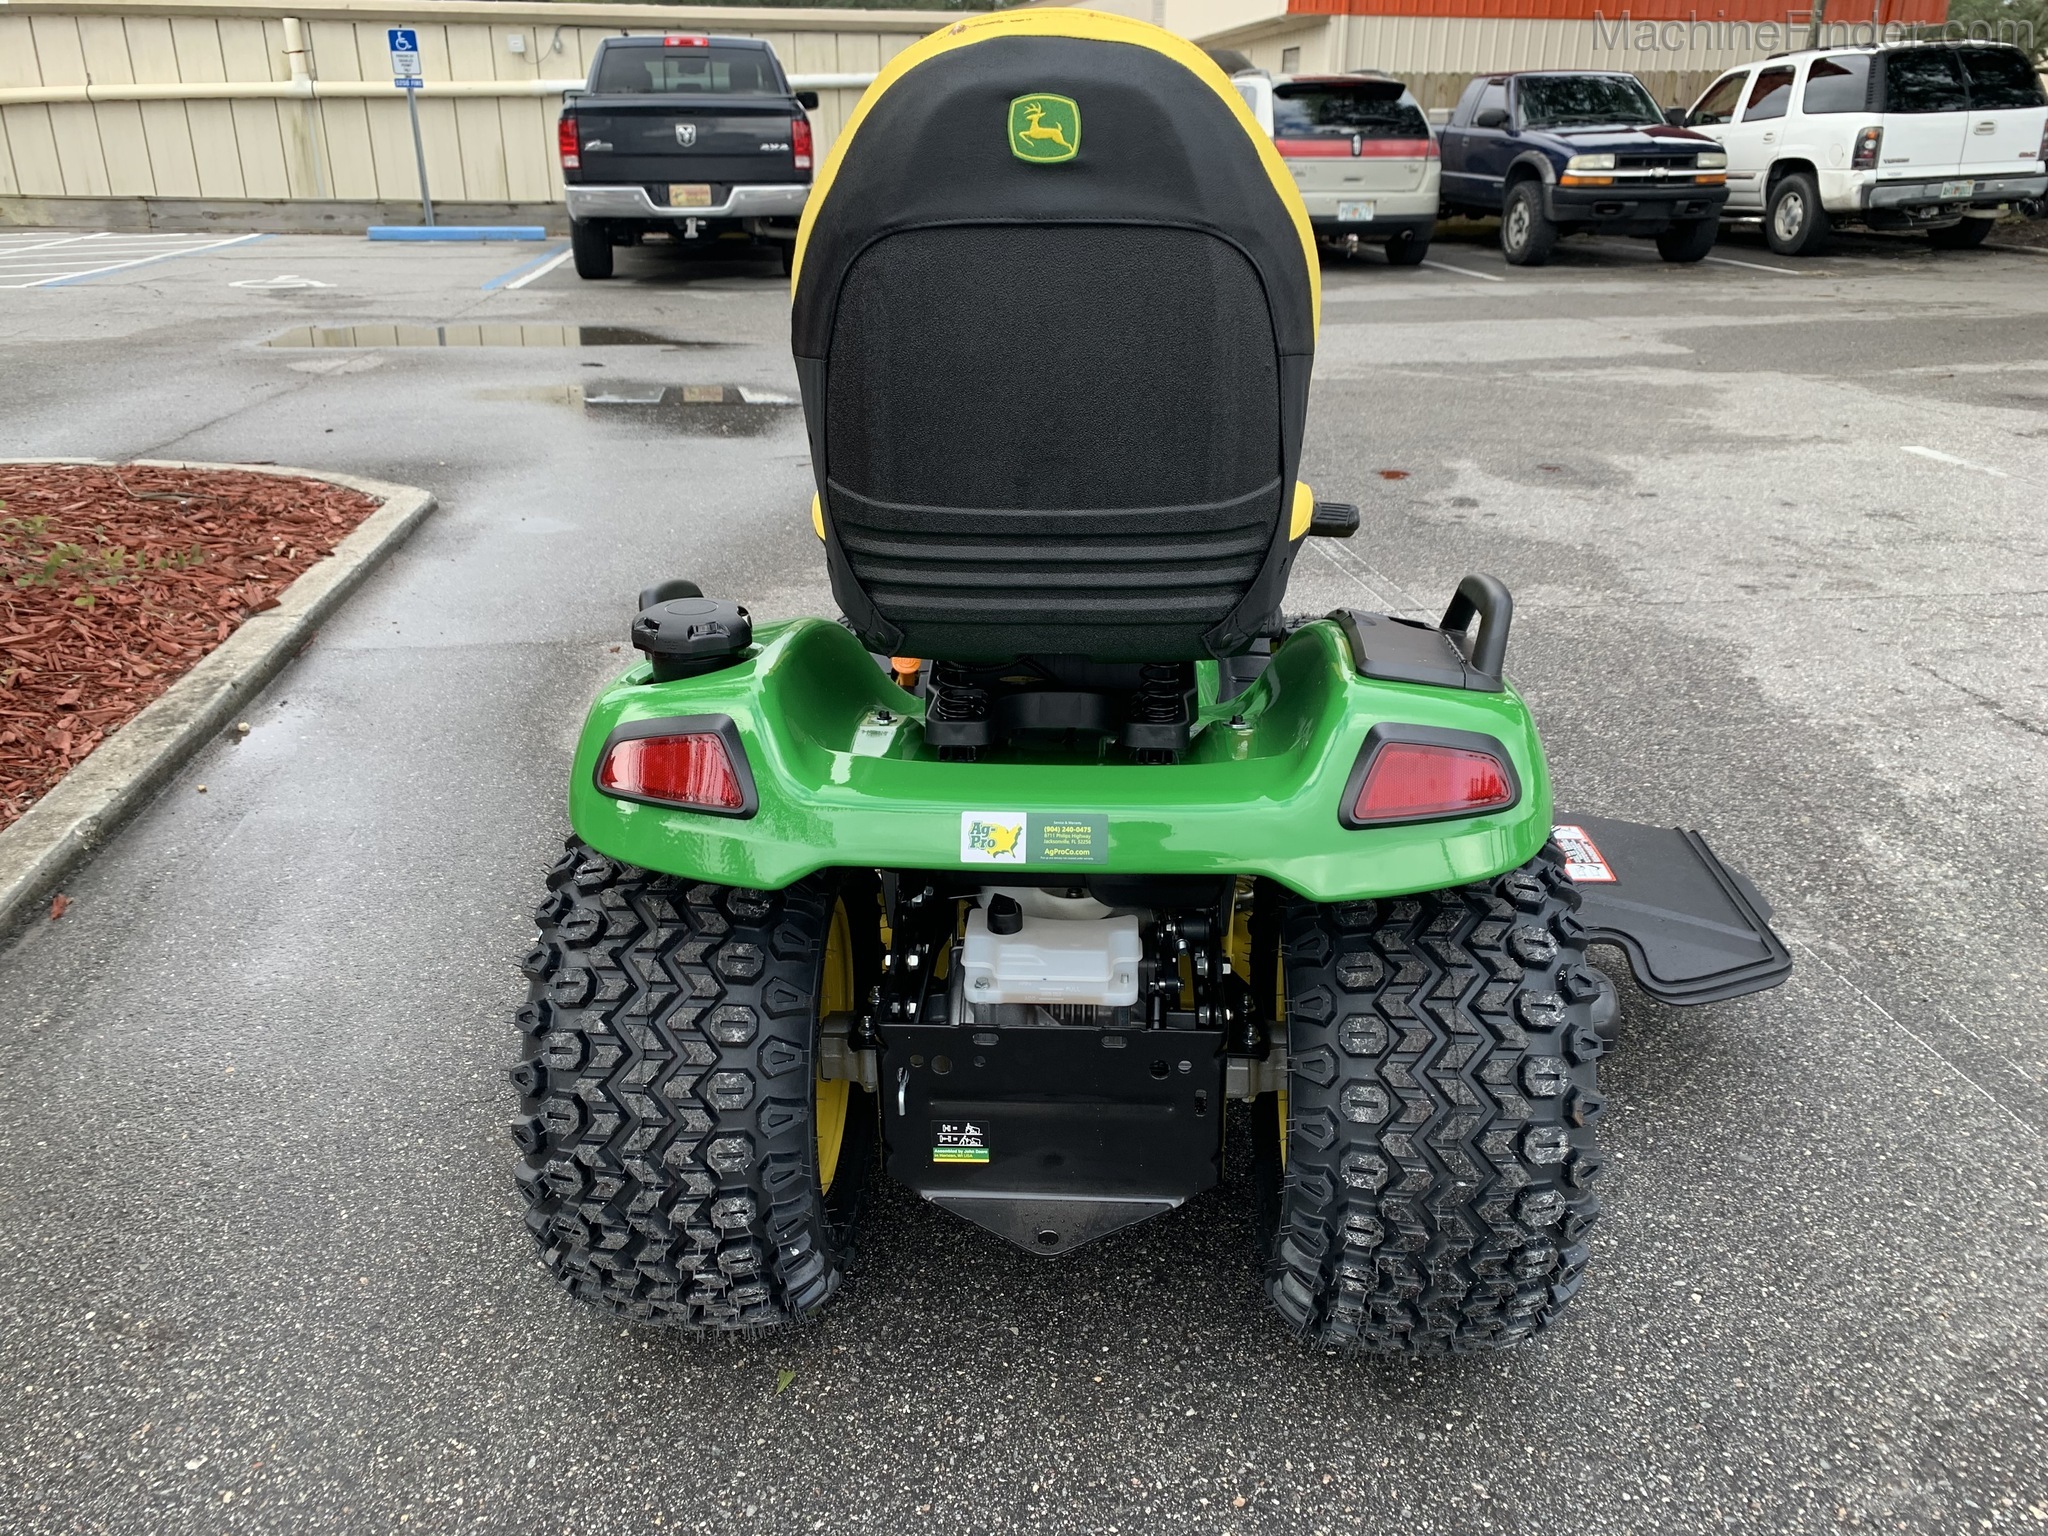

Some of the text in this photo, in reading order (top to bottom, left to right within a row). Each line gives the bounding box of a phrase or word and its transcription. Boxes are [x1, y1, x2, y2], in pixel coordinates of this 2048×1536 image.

[970, 822, 996, 838] Ag-
[970, 835, 996, 848] Pro
[1044, 848, 1090, 856] AgProCo.com
